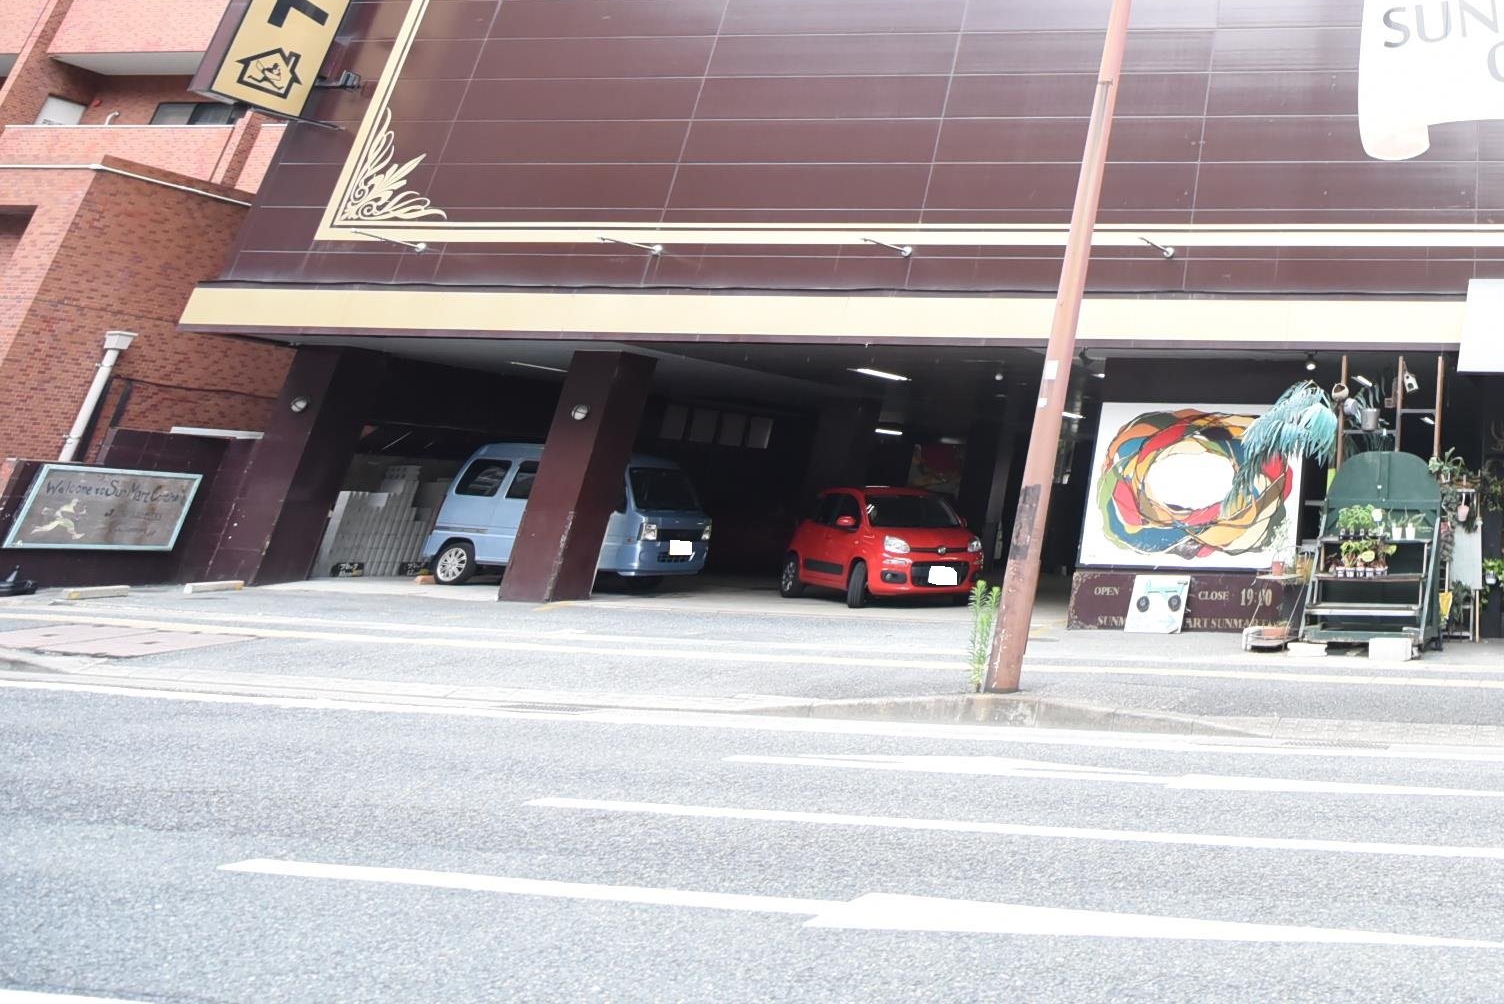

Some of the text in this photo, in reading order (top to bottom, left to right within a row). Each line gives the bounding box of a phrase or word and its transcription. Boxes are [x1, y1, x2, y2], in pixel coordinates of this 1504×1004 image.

[1094, 586, 1119, 596] OPEN
[1198, 590, 1230, 601] CLOSE
[1097, 615, 1127, 627] SUNM
